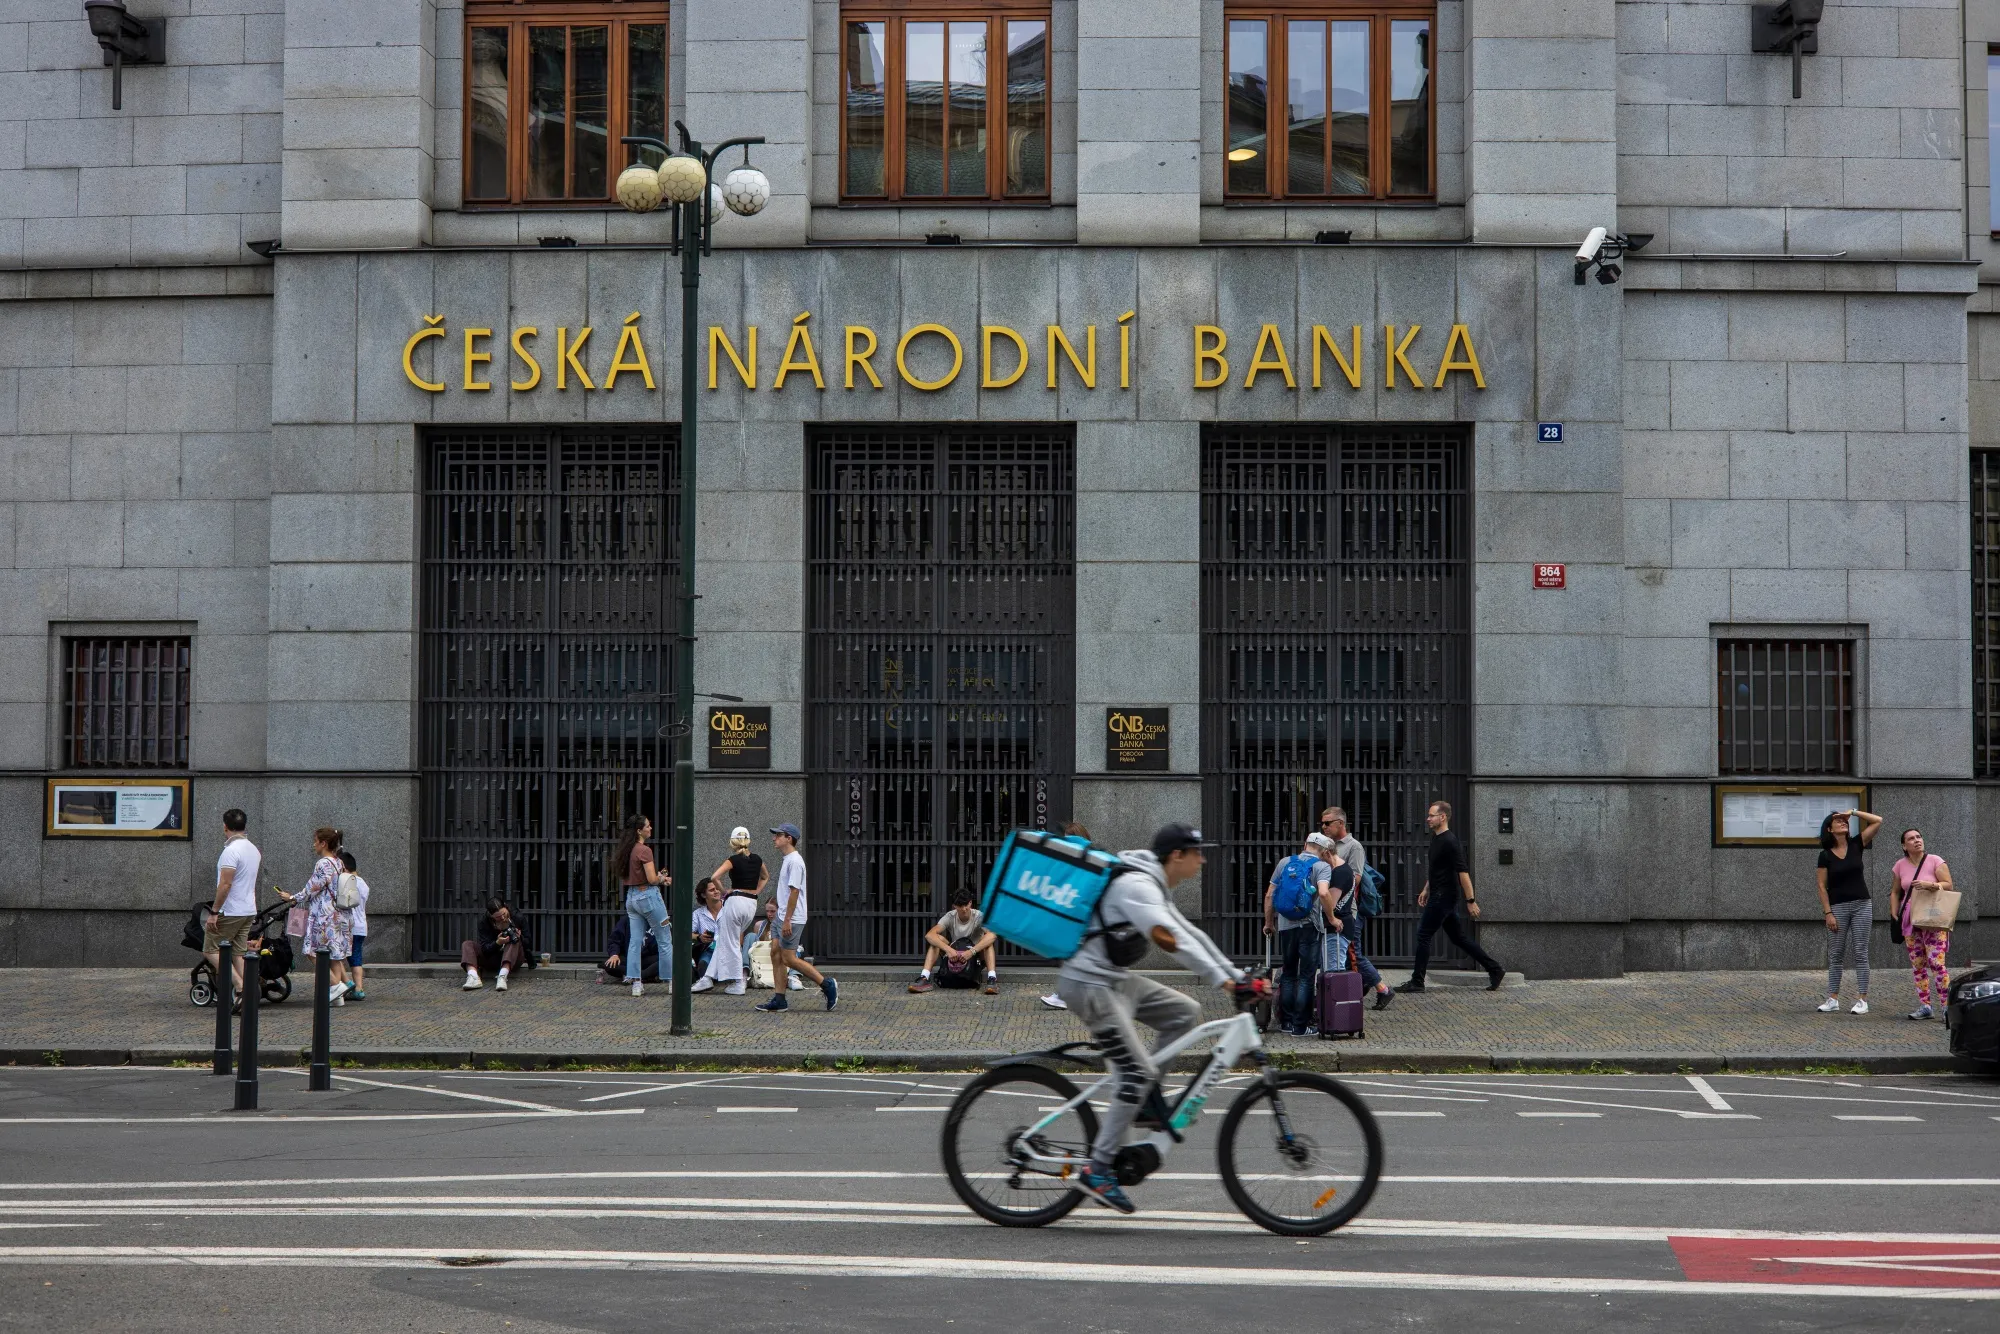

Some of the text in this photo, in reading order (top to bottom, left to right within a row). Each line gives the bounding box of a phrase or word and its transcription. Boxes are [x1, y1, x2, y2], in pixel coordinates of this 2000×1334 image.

[402, 310, 1487, 392] ČESKÁ NÁRODNÍ BANKA
[1543, 427, 1558, 438] 28
[1540, 566, 1560, 576] 864
[711, 711, 767, 731] ČNB ČESKÁ
[1109, 712, 1166, 732] ČNB ČESKÁ
[721, 730, 757, 738] NÁRODNÍ
[1119, 731, 1156, 740] NÁRODNÍ
[1119, 740, 1144, 748] BANKA
